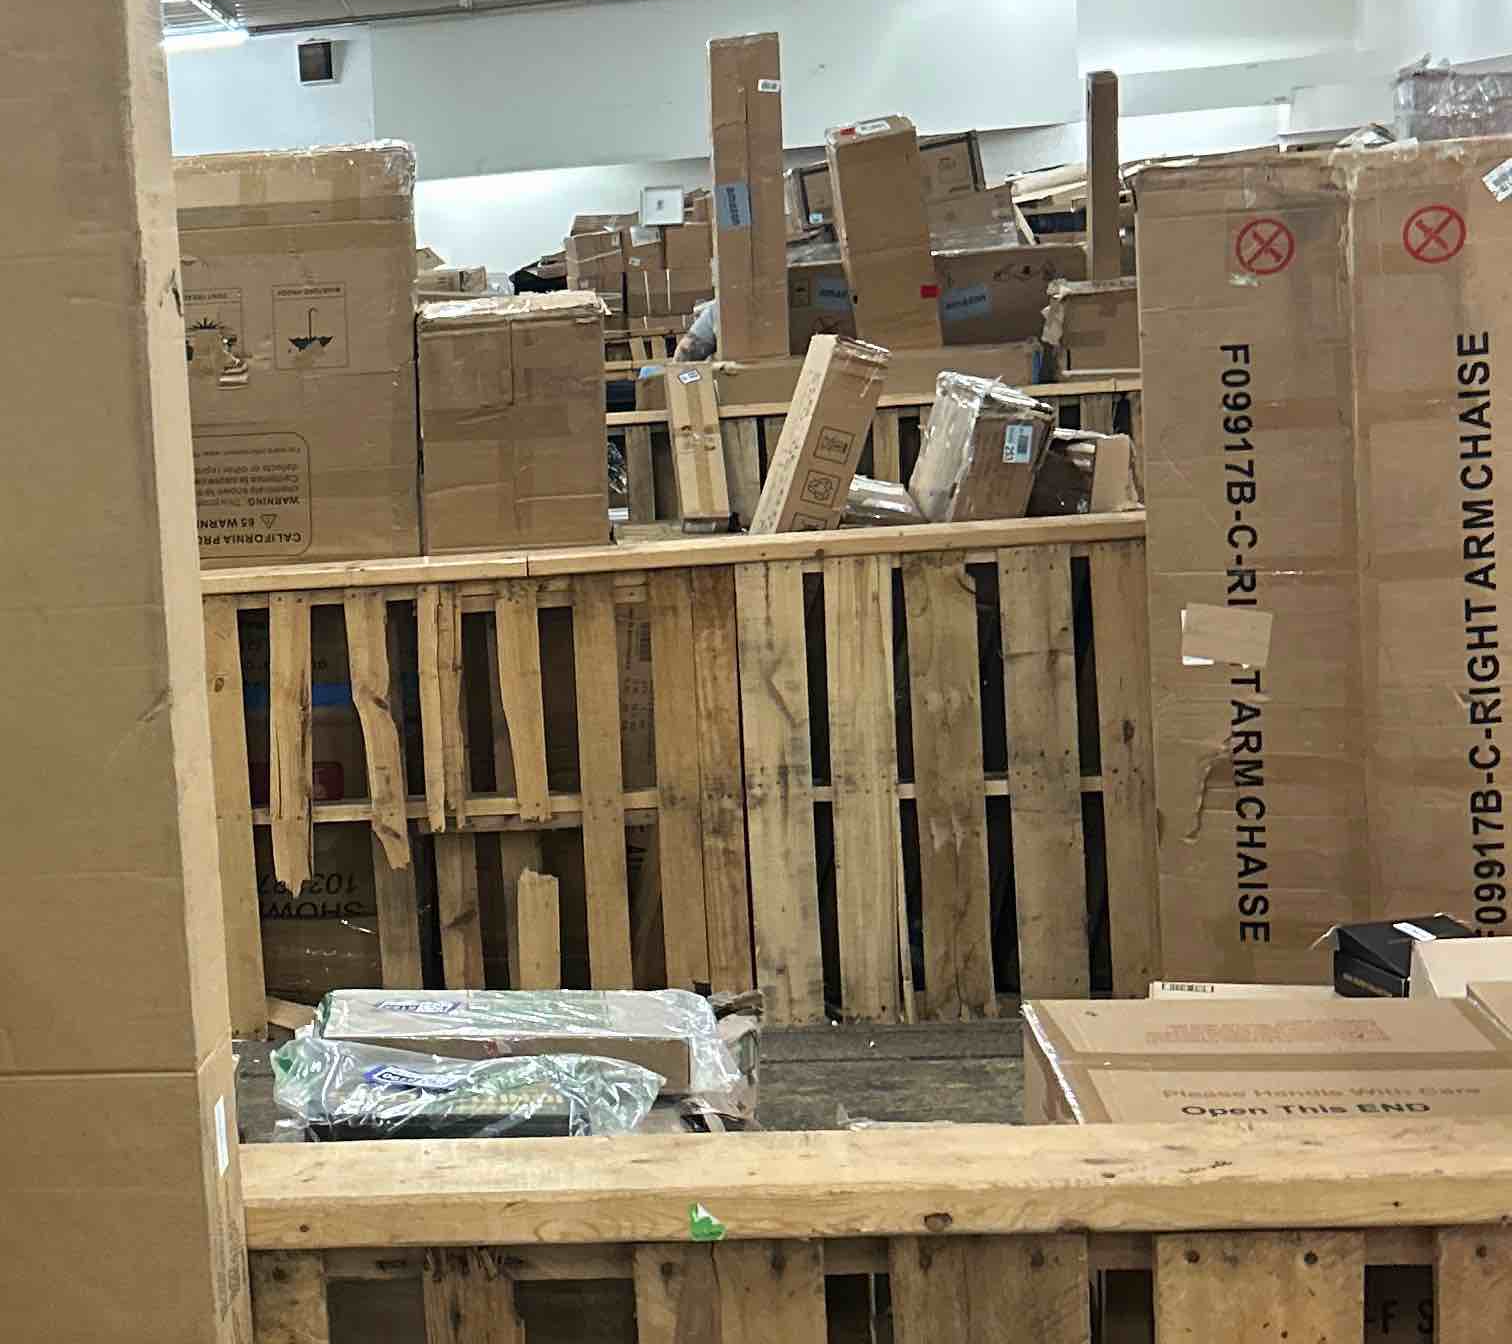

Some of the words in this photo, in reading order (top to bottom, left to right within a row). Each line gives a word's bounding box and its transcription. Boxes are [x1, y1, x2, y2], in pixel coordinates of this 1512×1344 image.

[1219, 343, 1261, 693] F09917B-C-RIT
[223, 532, 302, 544] CALIFORNIA
[1181, 1105, 1269, 1118] Open
[1277, 1103, 1348, 1115] This
[1356, 1102, 1432, 1114] END
